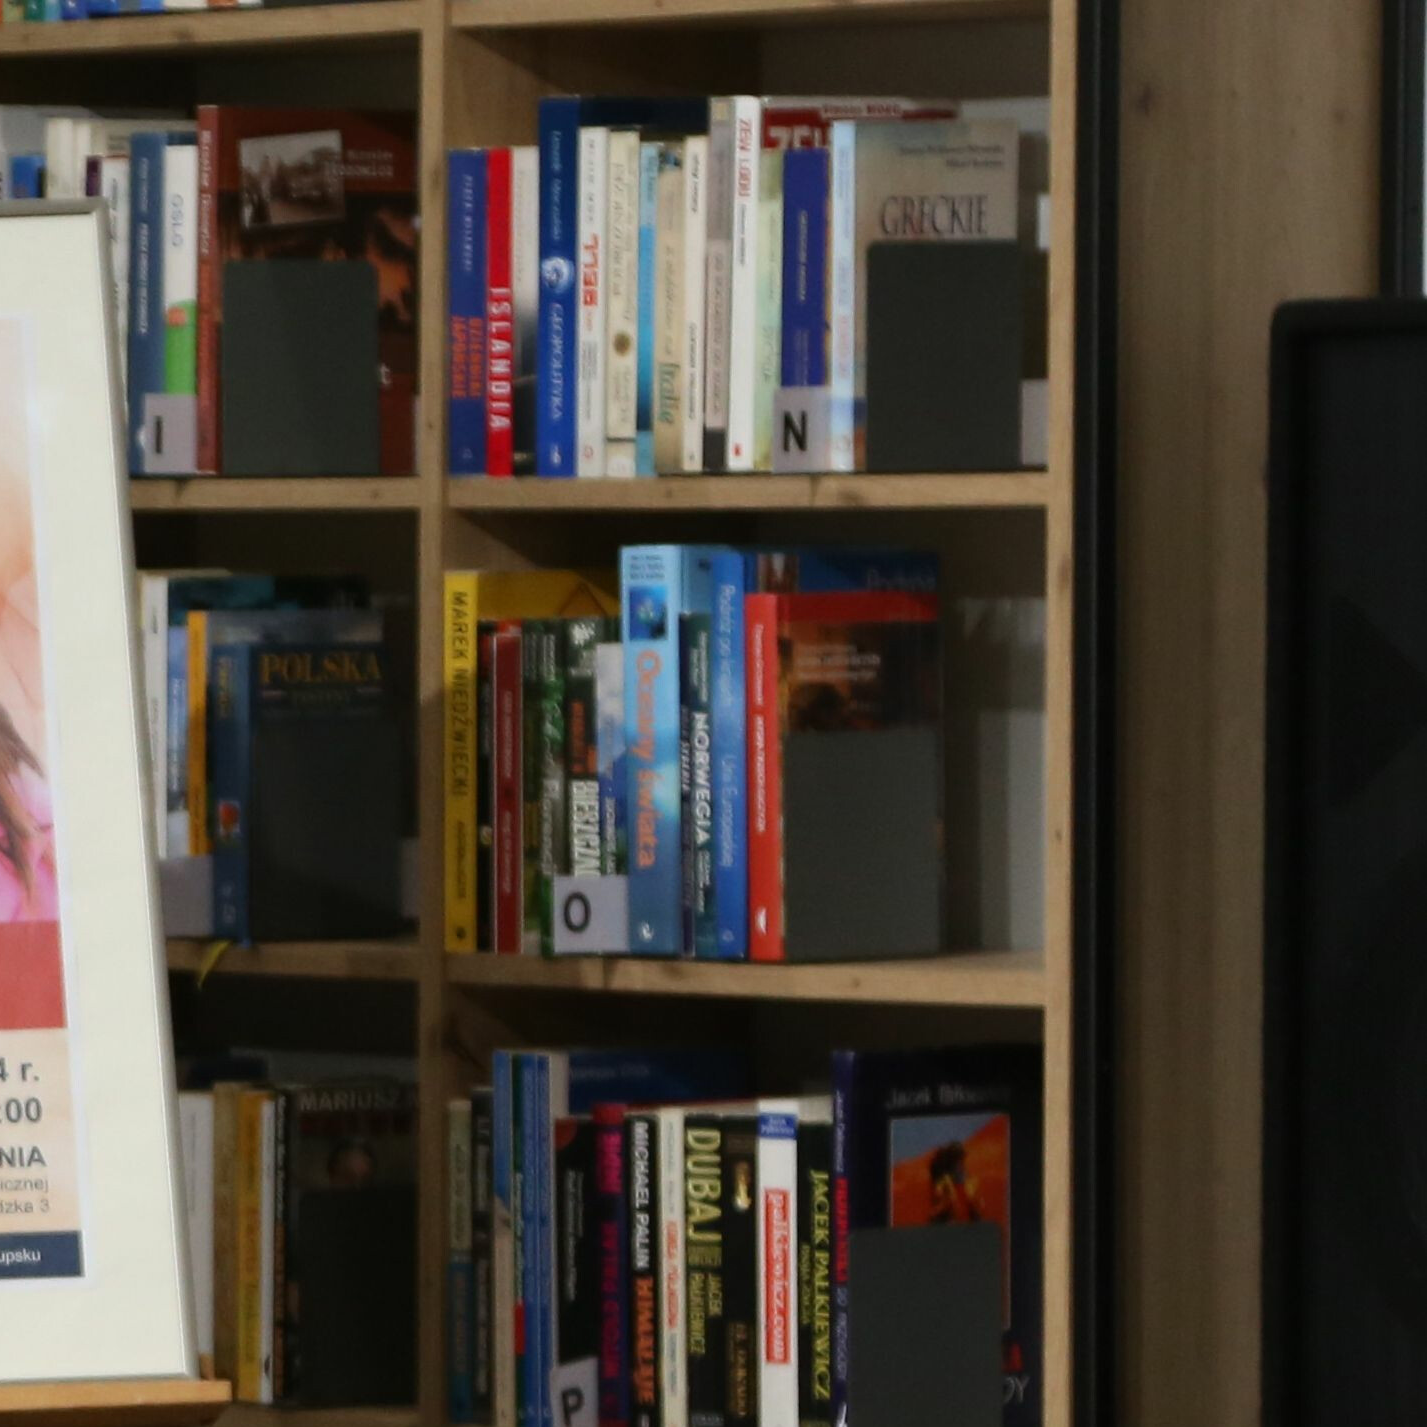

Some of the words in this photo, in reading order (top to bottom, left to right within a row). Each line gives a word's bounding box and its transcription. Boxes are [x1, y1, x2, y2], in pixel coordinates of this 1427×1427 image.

[171, 193, 185, 248] OSLO
[489, 287, 511, 432] ISLANDIA
[549, 302, 565, 420] GEOPOLITYKA
[783, 411, 808, 453] N
[451, 591, 470, 660] MAREK
[259, 651, 382, 684] POLSKA
[631, 650, 663, 760] Oceany
[451, 669, 474, 797] NIEDŹWIECKI
[691, 712, 713, 845] NORWEGIA
[636, 769, 664, 868] świata
[563, 891, 592, 933] O
[18, 1061, 41, 1084] r.
[887, 1087, 931, 1110] Jacek
[632, 1120, 650, 1209] MICHAEL
[686, 1128, 722, 1243] DUBAJ
[39, 1198, 50, 1212] 3
[632, 1212, 650, 1269] PALIN
[808, 1169, 832, 1245] JACEK
[689, 1272, 706, 1355] PAŁKIEWICZ
[707, 1273, 722, 1317] JACEK
[810, 1249, 832, 1401] PAŁKIEWICZ
[632, 1277, 654, 1404] HIMALAJE
